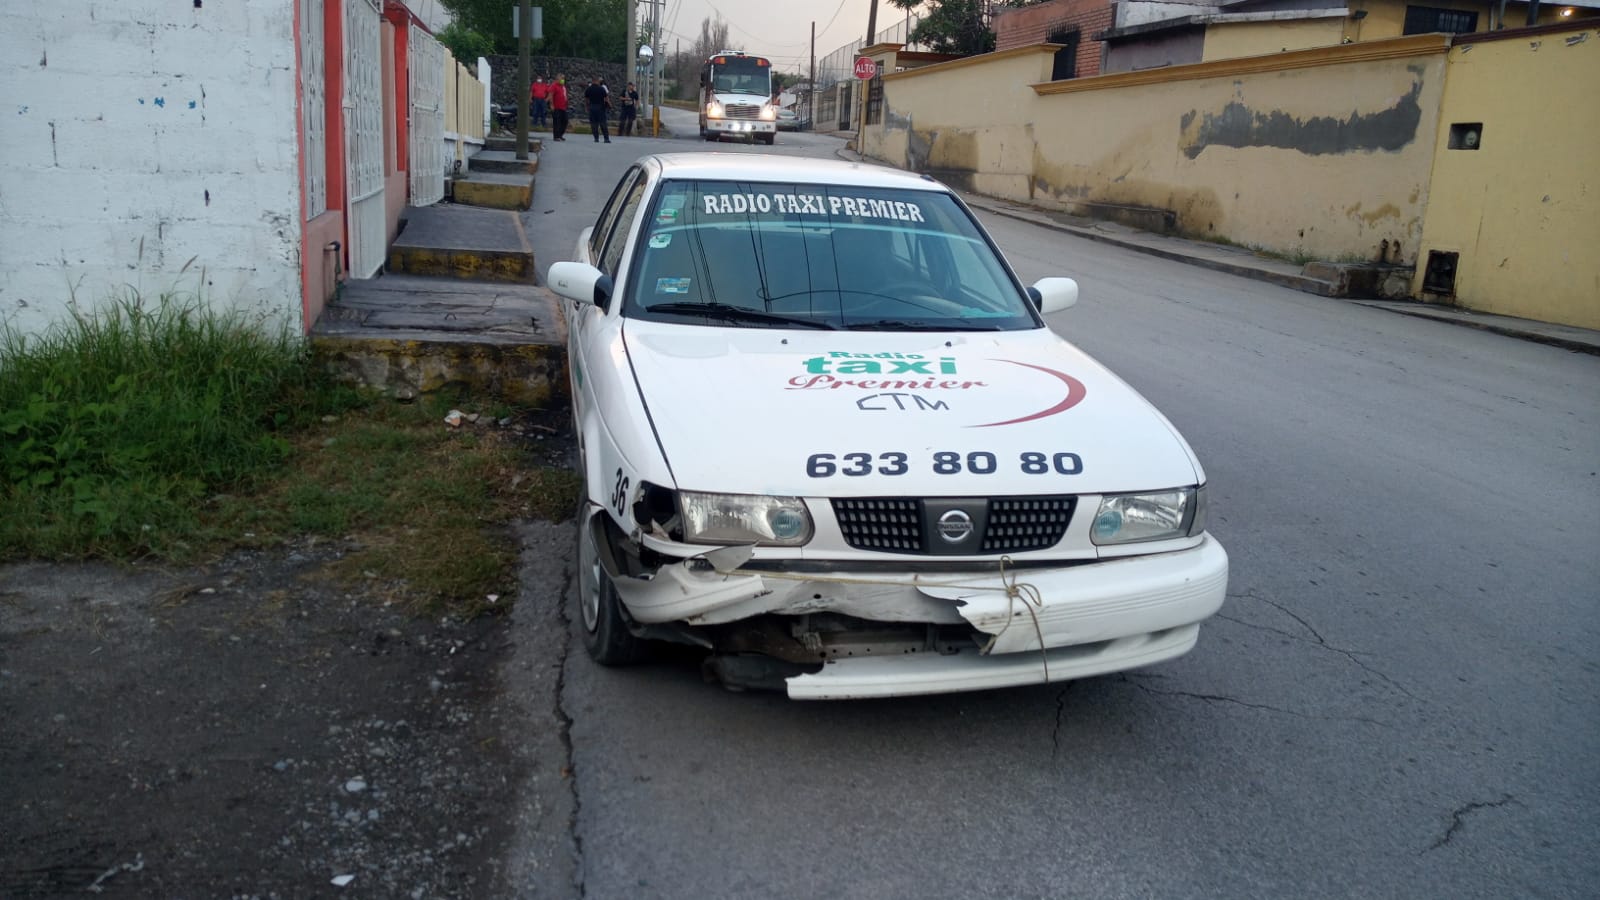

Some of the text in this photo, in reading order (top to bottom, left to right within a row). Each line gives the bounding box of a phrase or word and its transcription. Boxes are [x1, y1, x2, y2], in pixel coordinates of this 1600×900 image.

[856, 63, 875, 73] ALTO
[703, 194, 924, 222] RADIO TAXI PREMIER
[828, 351, 925, 360] Radio
[802, 357, 957, 374] taxi
[784, 374, 989, 390] Premier
[856, 392, 950, 411] CTM
[806, 451, 1084, 478] 633 80 80
[611, 467, 629, 517] 36
